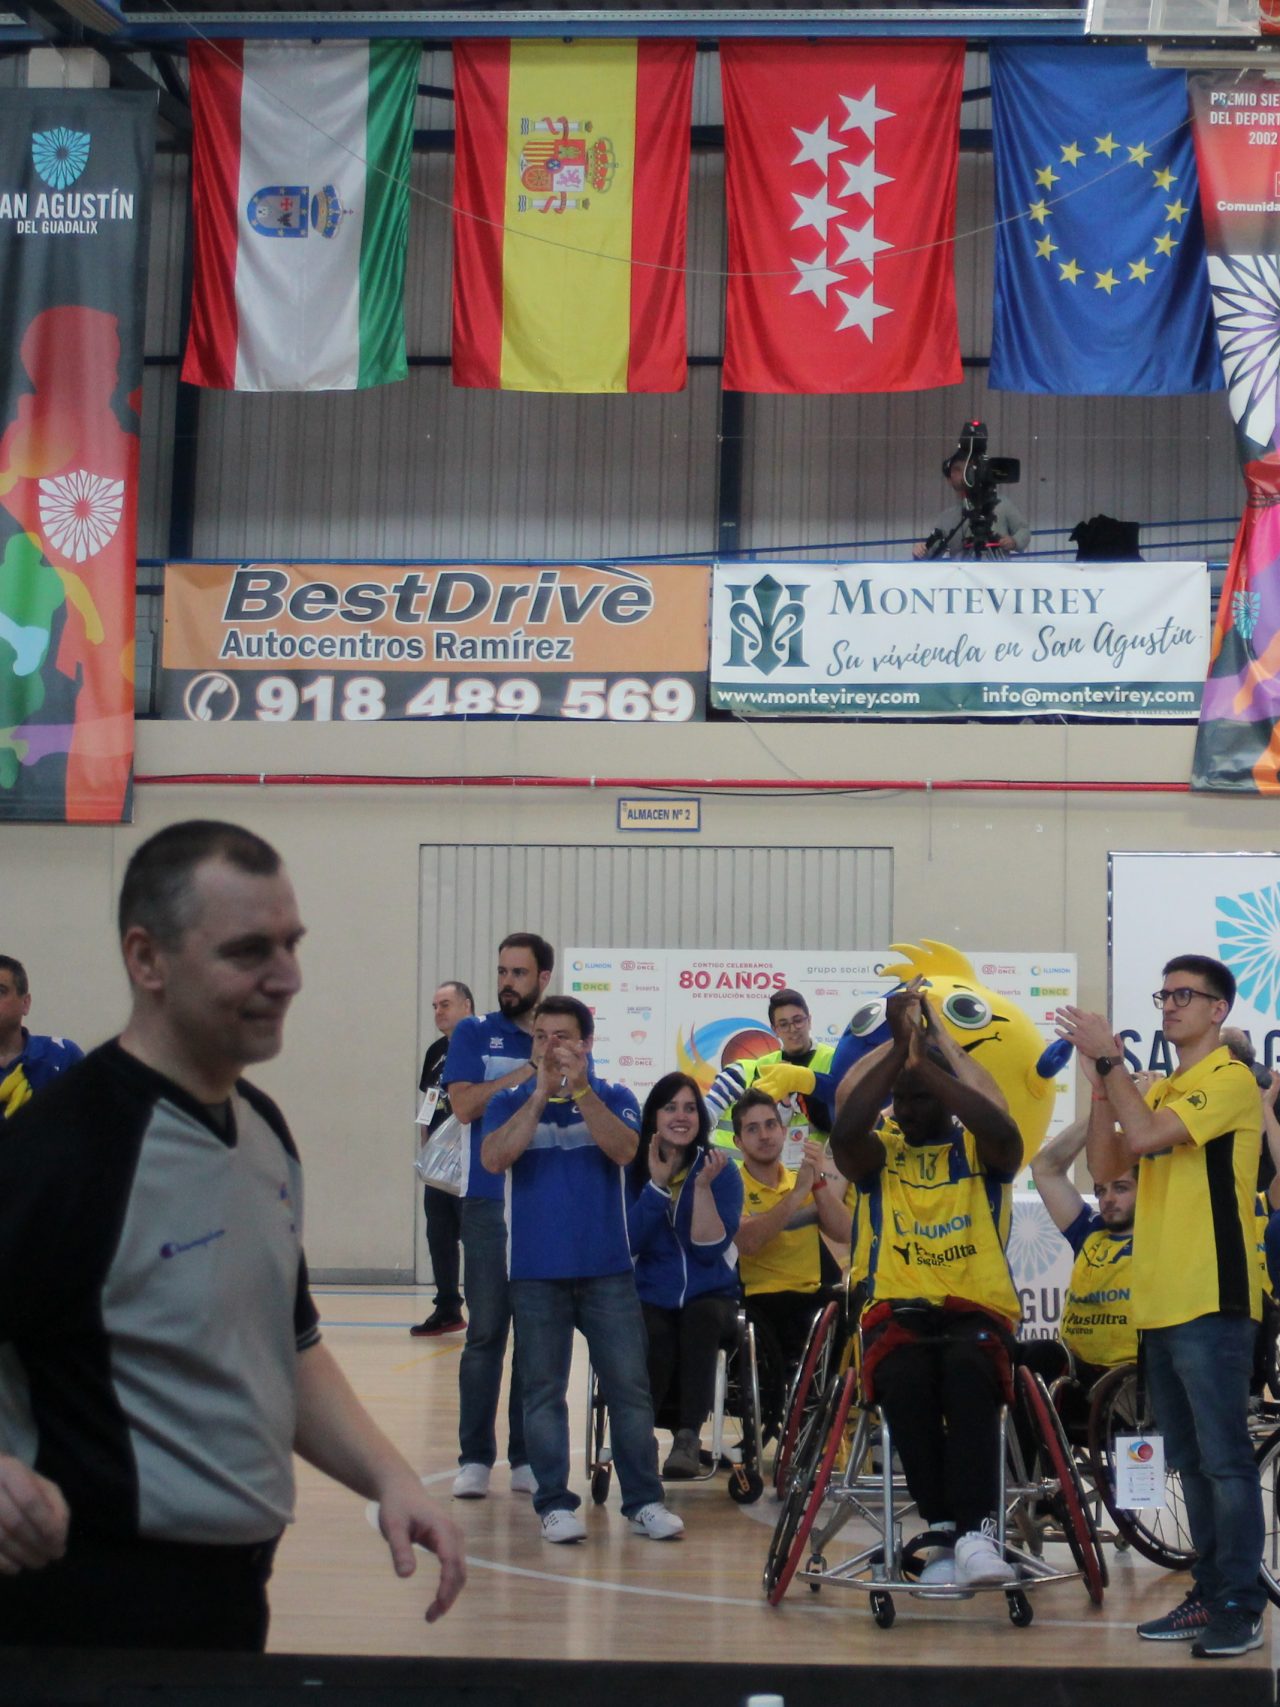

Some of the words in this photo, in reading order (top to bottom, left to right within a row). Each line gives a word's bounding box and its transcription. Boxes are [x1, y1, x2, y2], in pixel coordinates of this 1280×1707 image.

[1210, 92, 1257, 106] PREMIO
[1210, 112, 1232, 125] DEL
[1248, 132, 1278, 145] 2002
[0, 193, 28, 219] AN
[35, 188, 134, 219] AGUSTÍN
[17, 220, 38, 234] DEL
[41, 221, 98, 234] GUADALIX
[221, 567, 654, 625] BestDrive
[828, 579, 1106, 615] MONTEVIREY
[218, 629, 425, 660] Autocentros
[434, 628, 573, 661] Ramírez
[826, 640, 864, 677] Su
[872, 633, 985, 672] vivienda
[995, 642, 1023, 661] en
[1032, 624, 1085, 662] San
[1094, 616, 1197, 669] Agustín
[256, 676, 386, 721] 918
[405, 677, 541, 717] 489
[560, 677, 695, 721] 569
[718, 688, 920, 709] www.montevirey.com
[982, 685, 1195, 706] info@montevirey.com
[628, 808, 669, 820] ALMACEN
[685, 809, 690, 820] 2
[807, 966, 837, 974] grupo
[679, 971, 711, 990] 80
[716, 971, 787, 991] AÑOS
[1121, 1029, 1175, 1075] SA
[917, 1152, 939, 1181] 13
